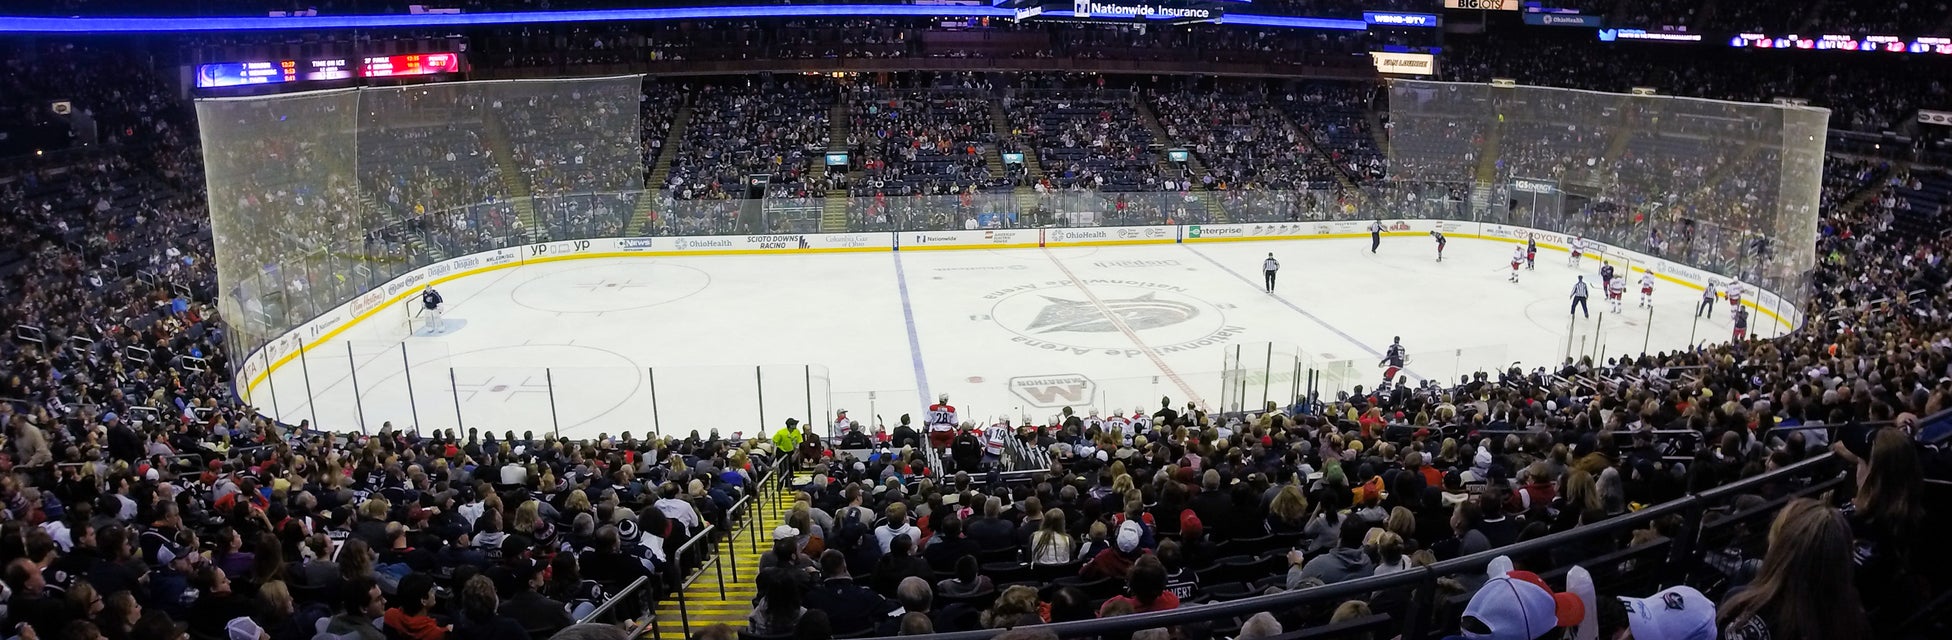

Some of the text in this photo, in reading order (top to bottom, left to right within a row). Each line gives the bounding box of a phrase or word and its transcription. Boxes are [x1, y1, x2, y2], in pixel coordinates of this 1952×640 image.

[1458, 0, 1478, 8] BIG
[1091, 3, 1209, 18] Nationwide Insurance
[1515, 180, 1551, 192] IGS ENERGY
[1066, 230, 1106, 239] OhioHealth
[1193, 227, 1241, 237] enterprise
[689, 240, 732, 248] OhioHealth
[773, 235, 798, 243] DOWNS
[531, 243, 547, 256] yp
[574, 240, 590, 252] yp
[453, 257, 479, 270] Dispatch
[1667, 266, 1702, 282] OhioHealth
[982, 283, 1037, 299] Arena
[1011, 325, 1247, 358] Nationwide Arena
[1018, 377, 1081, 387] MARATHON
[936, 413, 948, 424] 28
[995, 428, 1005, 440] 19
